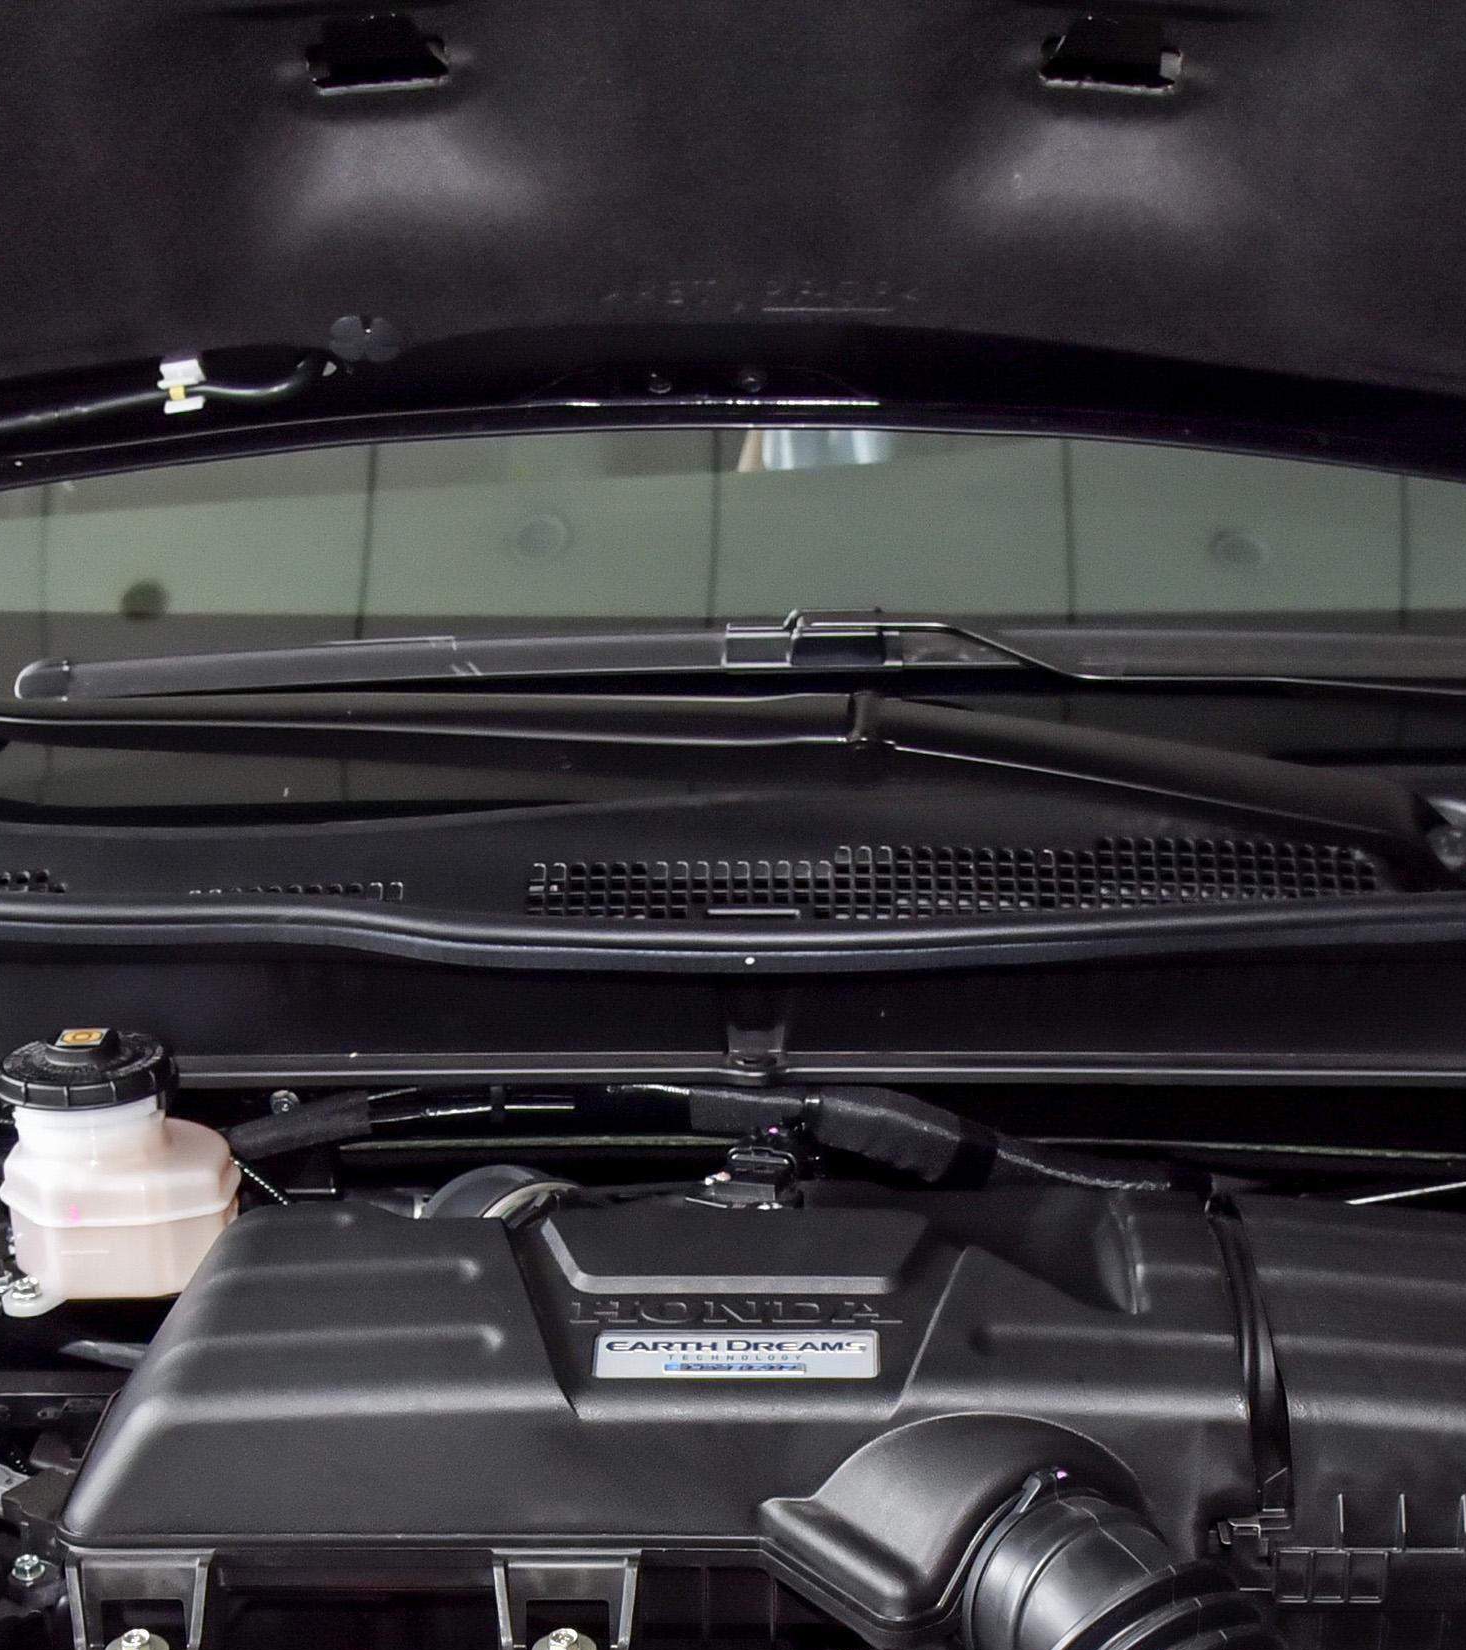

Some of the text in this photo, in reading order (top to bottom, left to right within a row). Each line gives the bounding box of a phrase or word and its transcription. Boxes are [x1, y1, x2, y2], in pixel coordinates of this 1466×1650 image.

[568, 1299, 905, 1324] HONDA
[605, 1338, 867, 1352] EARTH DREAMS
